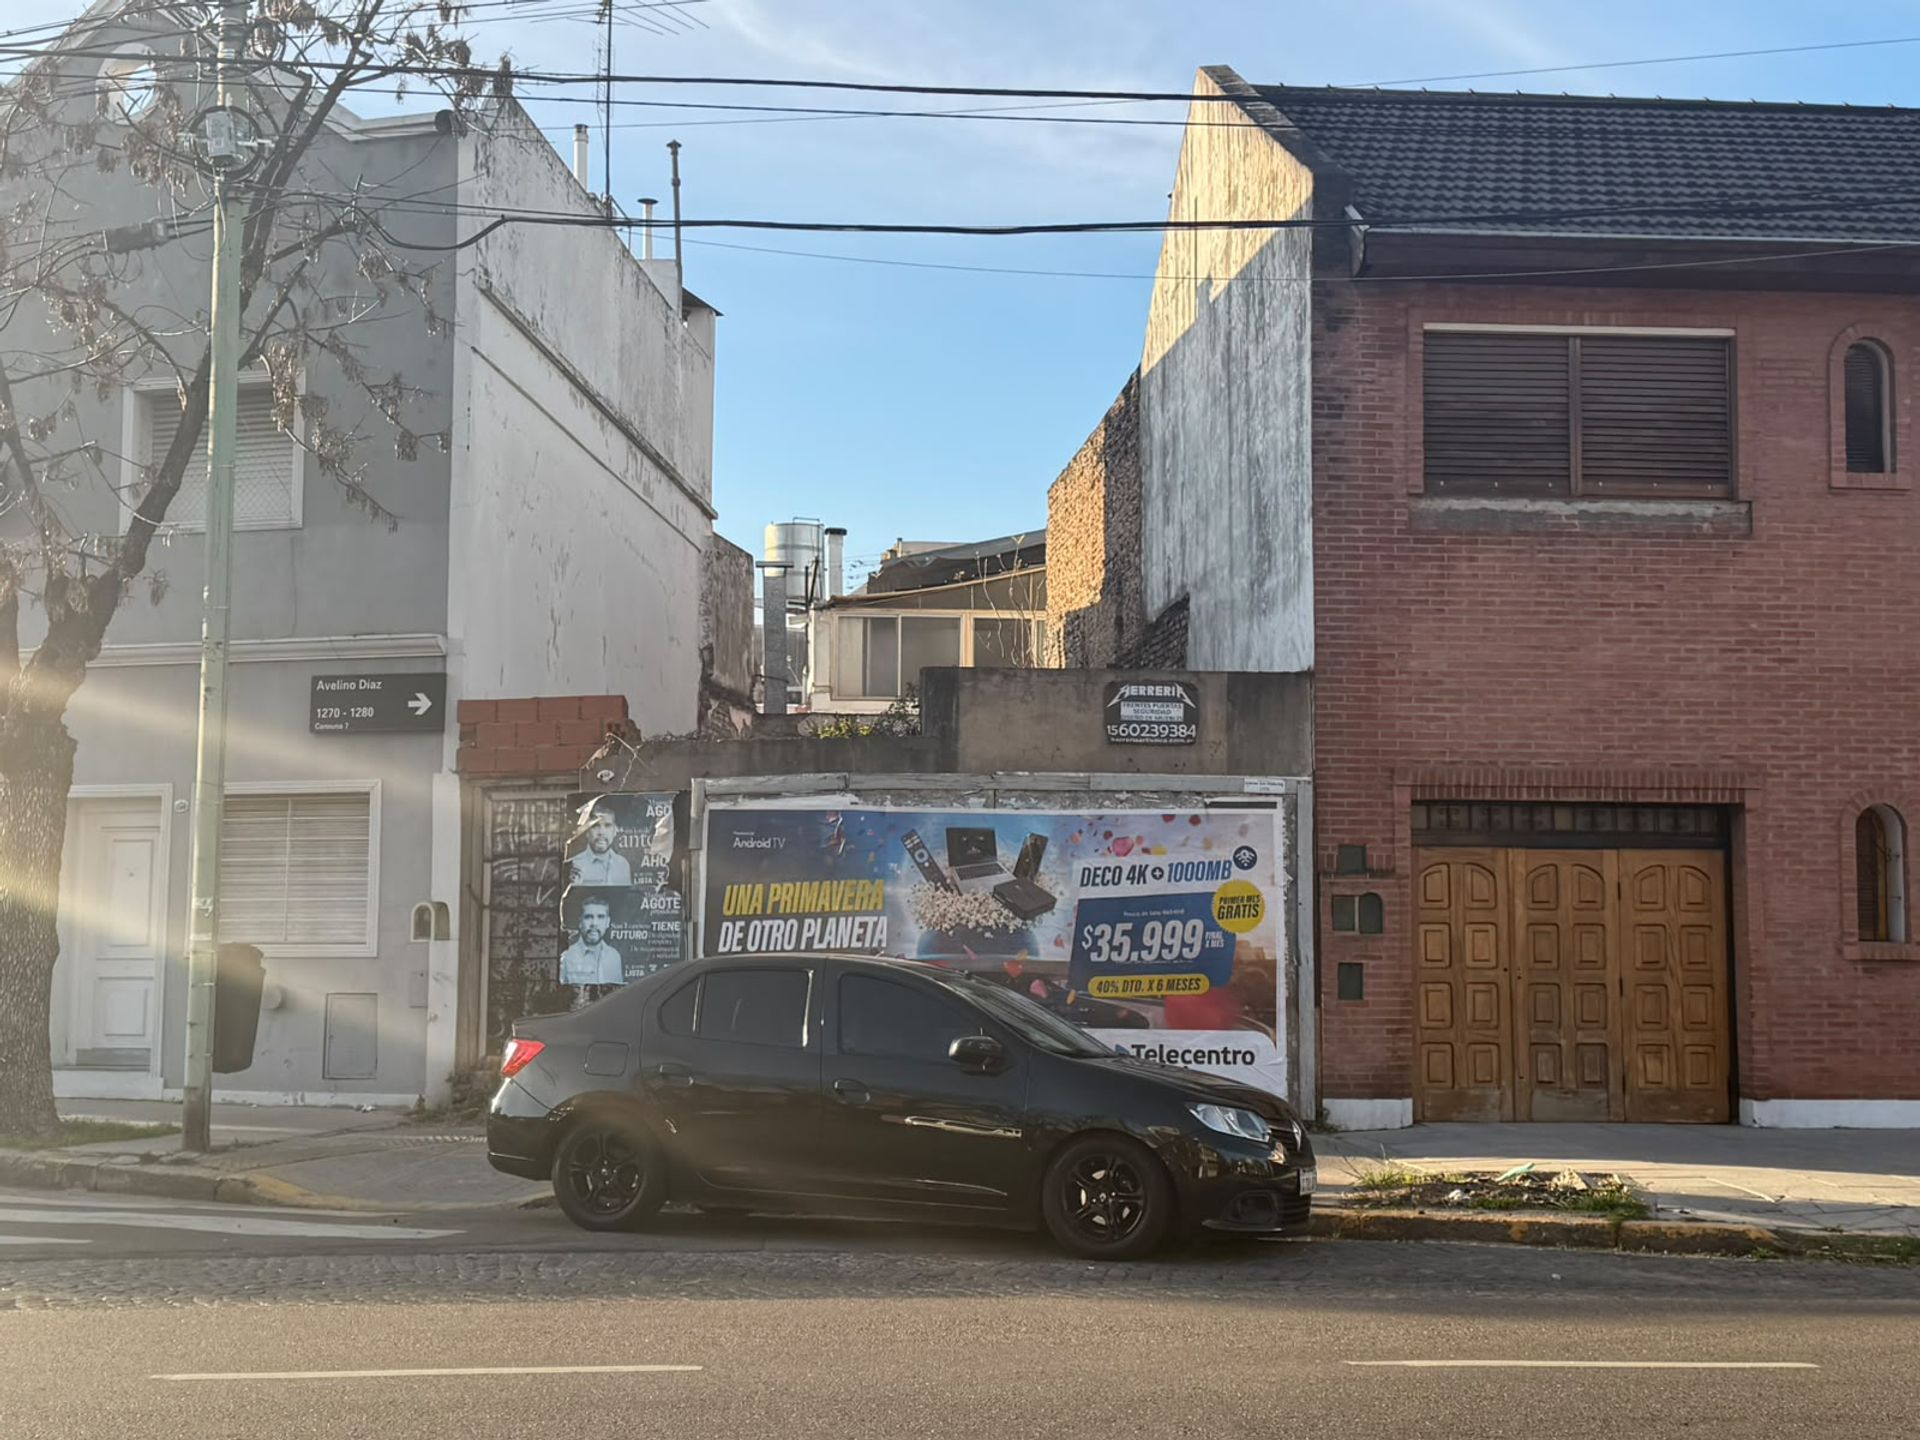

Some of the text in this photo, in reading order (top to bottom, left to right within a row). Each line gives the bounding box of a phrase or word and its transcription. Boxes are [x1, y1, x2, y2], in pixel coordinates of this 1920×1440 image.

[316, 679, 356, 691] Avelino
[316, 708, 340, 719] 1270
[350, 707, 374, 718] 1280
[1107, 724, 1196, 737] 1560239384
[733, 837, 786, 848] Android TV
[1080, 865, 1122, 887] DECO
[1126, 864, 1149, 885] 4K
[1167, 860, 1233, 883] 1000MB
[640, 897, 681, 910] AGOTE
[722, 879, 885, 916] UNA PRIMAVERA
[1217, 904, 1259, 920] GRATIS
[651, 921, 681, 931] TIENE
[610, 930, 648, 940] FUTURO
[718, 916, 888, 952] DE OTRO PLANETA
[1081, 919, 1204, 963] $35.999
[1096, 978, 1201, 994] 40% DTO. X 6 MESES
[1131, 1044, 1255, 1066] Telecentro
